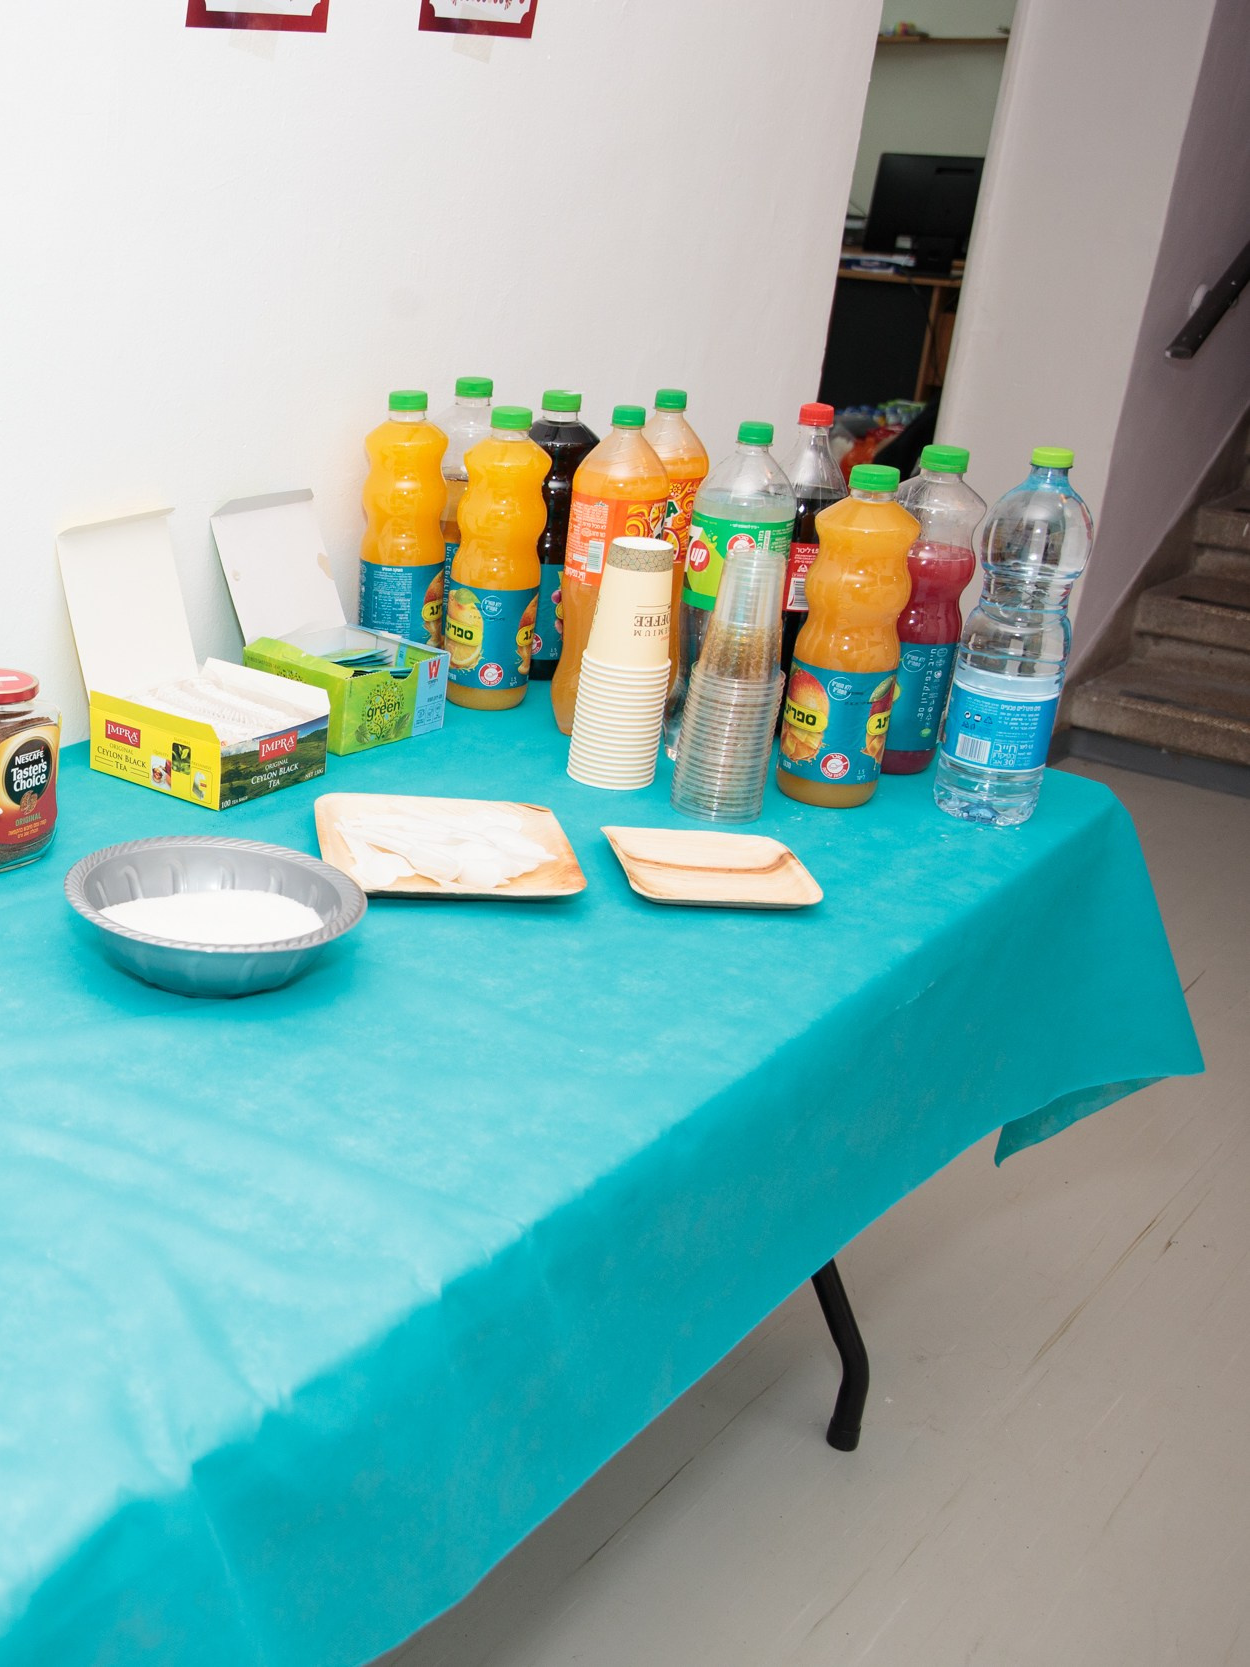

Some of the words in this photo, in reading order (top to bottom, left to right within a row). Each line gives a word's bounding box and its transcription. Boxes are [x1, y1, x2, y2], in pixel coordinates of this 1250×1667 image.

[633, 612, 670, 628] OFFEE
[446, 622, 474, 641] ספרינ
[928, 648, 938, 667] חייב
[920, 671, 933, 704] בפיקדון
[366, 700, 401, 723] green
[785, 703, 817, 727] ספרינ
[107, 723, 139, 745] IMPRA
[109, 742, 135, 756] ORIGINAL
[261, 735, 295, 758] IMPRA
[97, 745, 123, 761] CEYLON
[124, 755, 147, 770] BLACK
[114, 761, 128, 773] TEA
[265, 758, 289, 770] ORIGINAL
[11, 759, 48, 782] Taster's
[251, 769, 278, 785] CEYLON
[278, 761, 300, 777] BLACK
[13, 773, 47, 792] Choice
[268, 778, 281, 789] TEA
[15, 813, 42, 827] ORIGINAL
